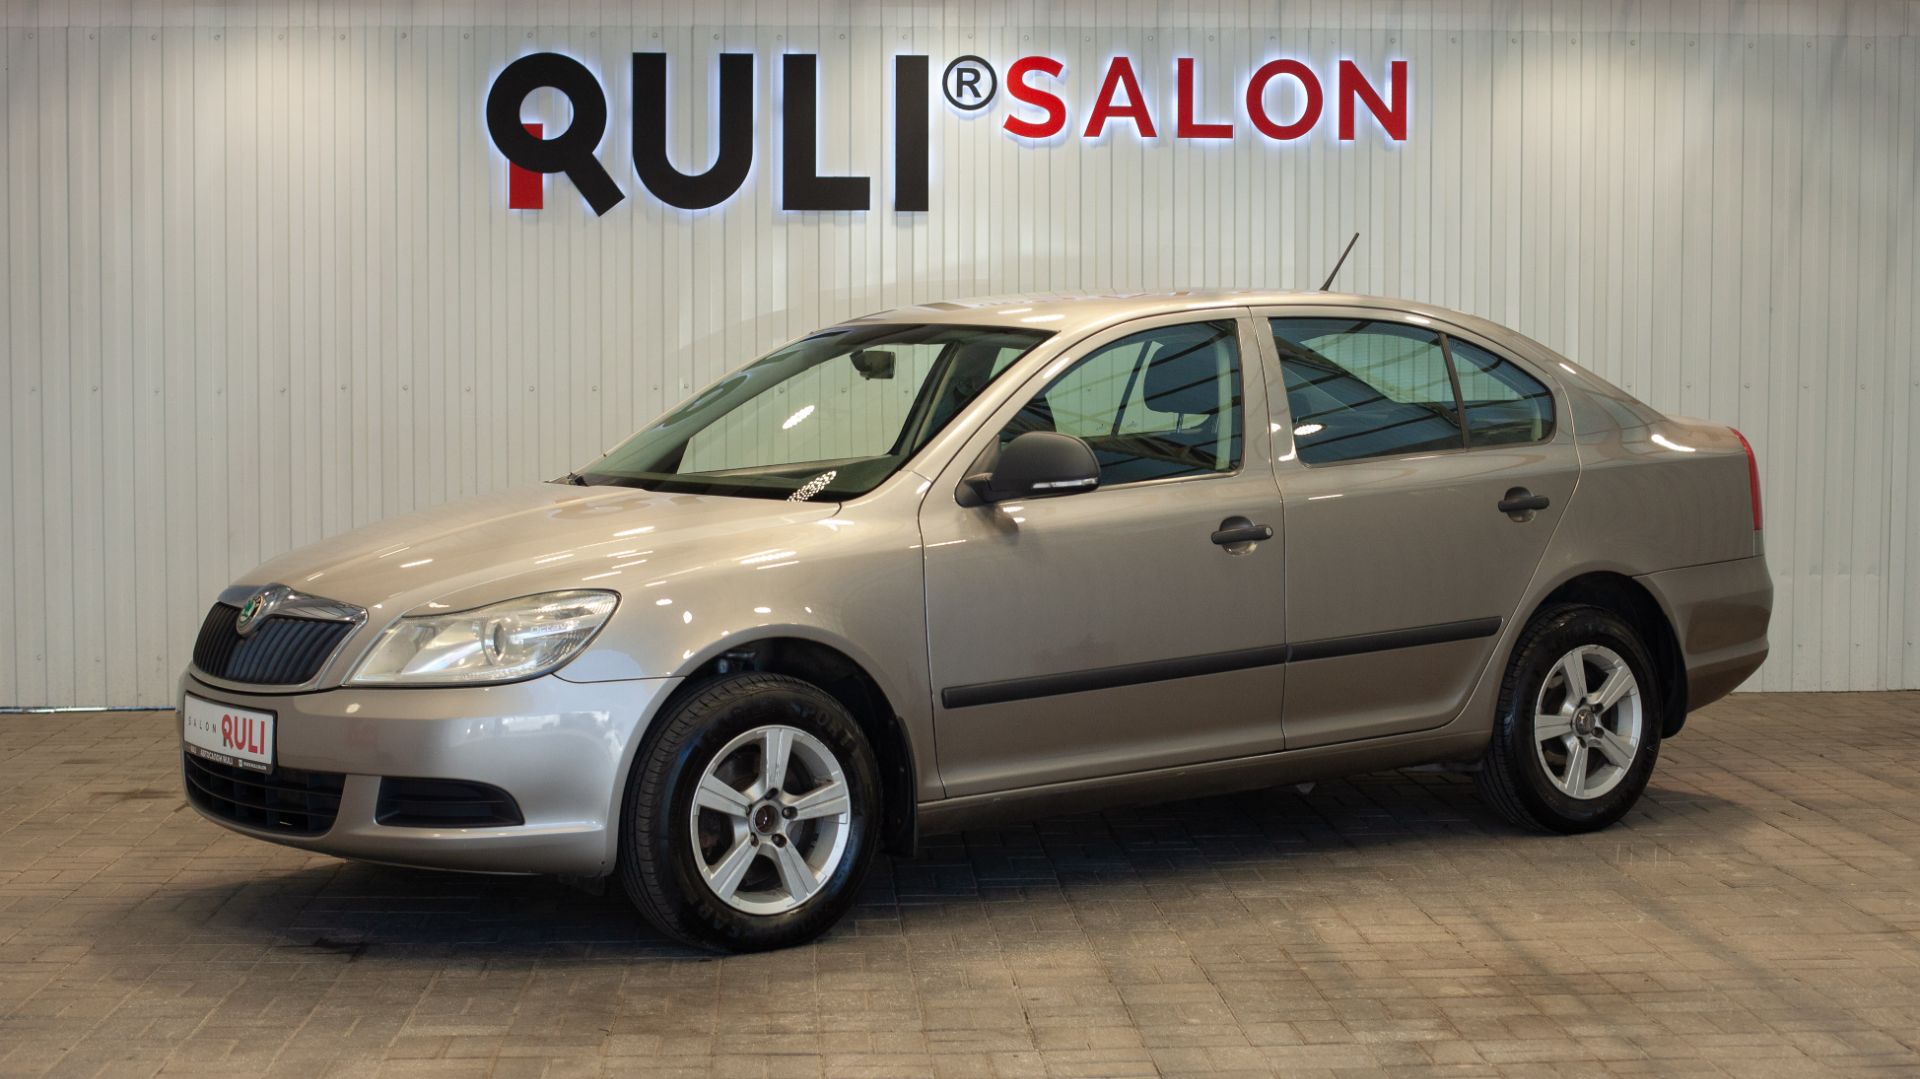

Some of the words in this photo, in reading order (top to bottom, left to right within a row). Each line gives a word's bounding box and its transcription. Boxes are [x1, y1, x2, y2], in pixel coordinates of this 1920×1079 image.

[1003, 55, 1408, 141] SALON
[188, 715, 217, 734] SALON
[222, 713, 265, 755] RULI
